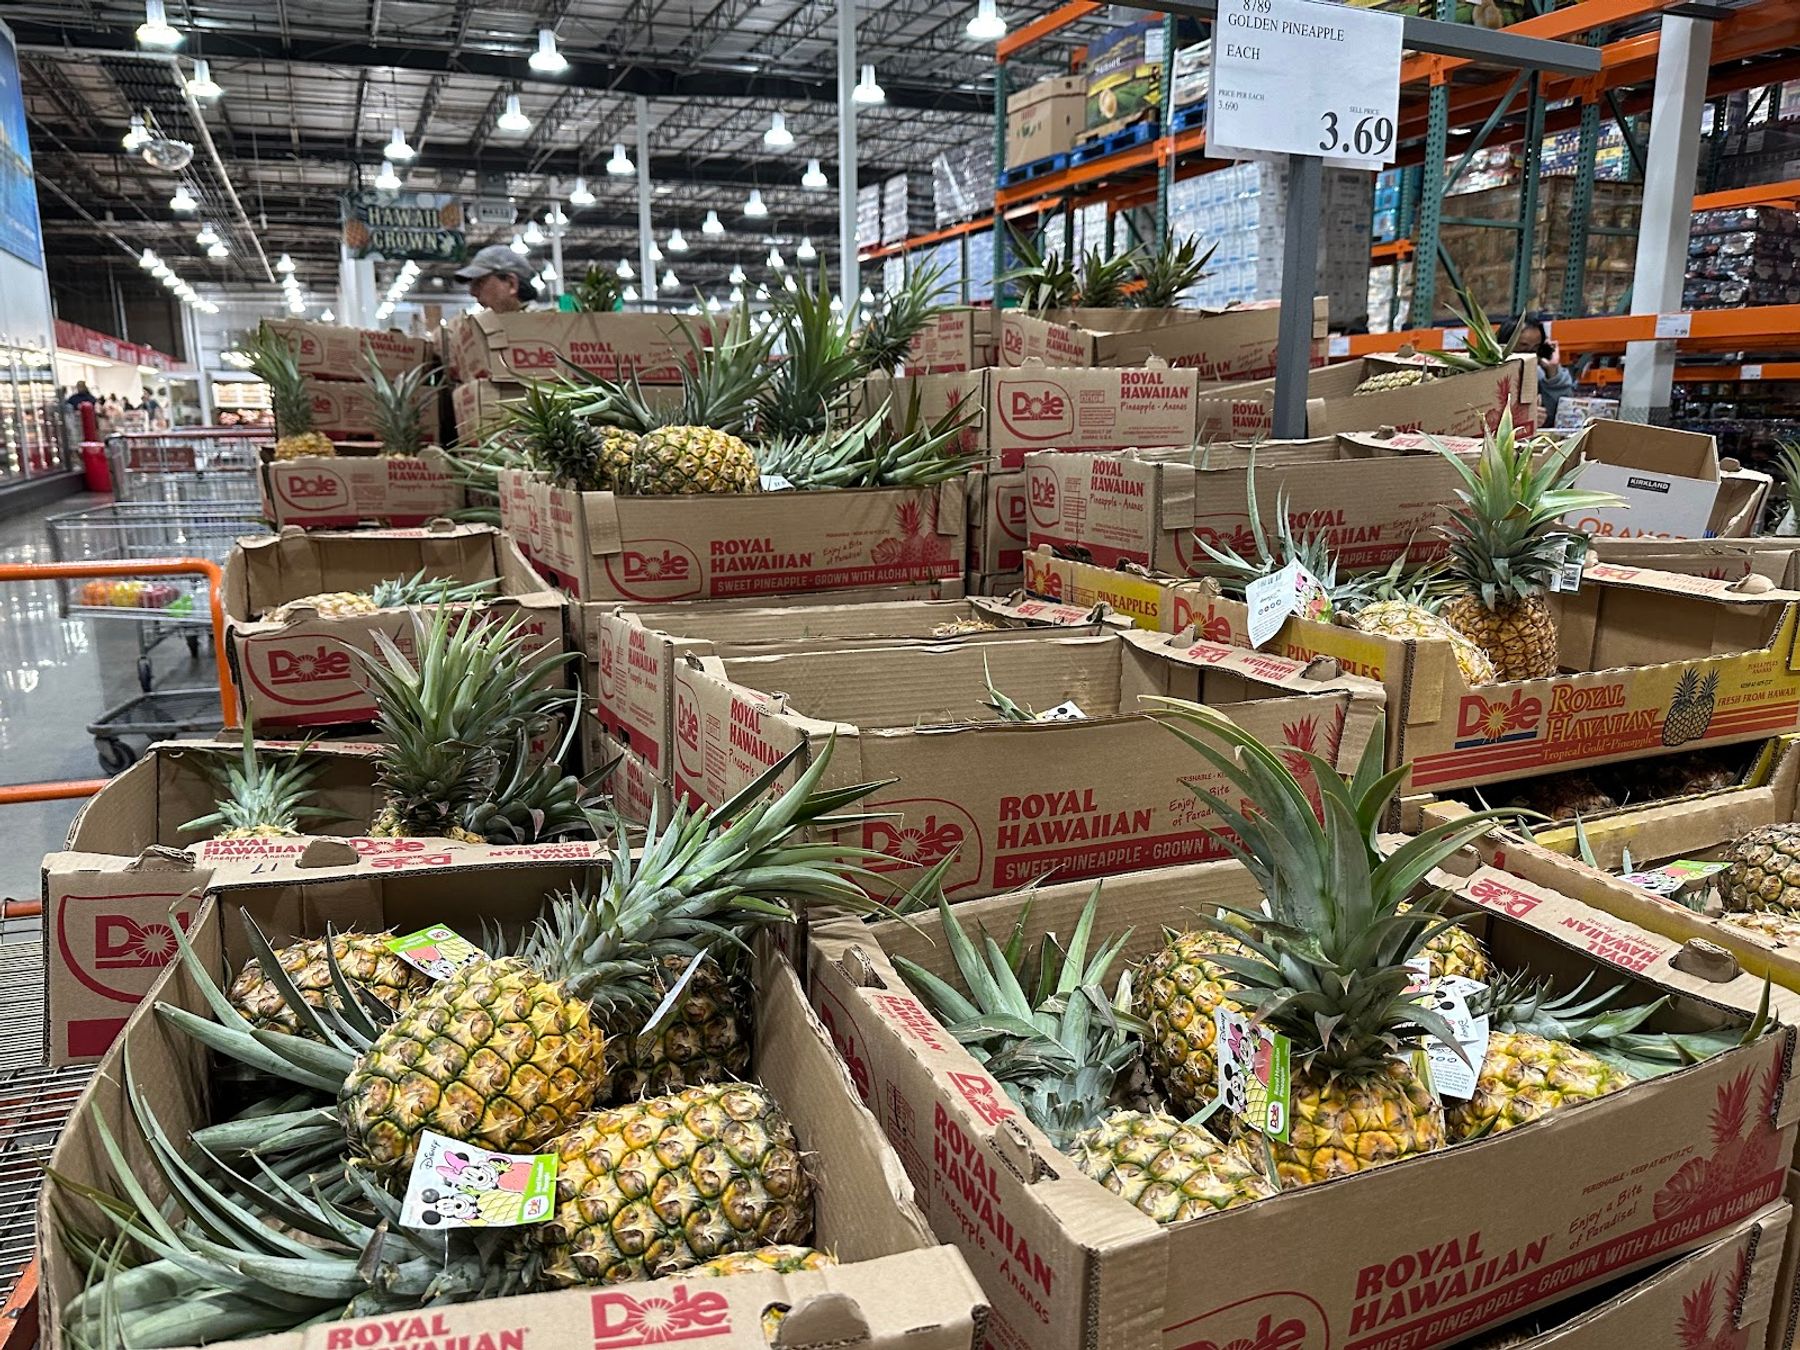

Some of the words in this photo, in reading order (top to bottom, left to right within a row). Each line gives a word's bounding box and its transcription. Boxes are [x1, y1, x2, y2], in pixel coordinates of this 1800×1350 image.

[1243, 0, 1272, 14] 8789
[1228, 13, 1279, 32] GOLDEN
[1282, 21, 1345, 42] PINEAPPLE
[1226, 44, 1260, 60] EACH
[1218, 100, 1239, 111] 3.690
[1349, 106, 1362, 114] SELL
[1319, 112, 1393, 155] 3.69
[368, 206, 438, 227] HAWAII
[372, 231, 438, 250] GROWN
[1005, 329, 1022, 350] Dole
[1048, 328, 1069, 340] ROYAL
[512, 348, 556, 364] Dole
[570, 341, 613, 352] ROYAL
[570, 353, 642, 365] HAWAIIAN
[1200, 361, 1231, 376] AIIAN
[1121, 373, 1164, 384] ROYAL
[1121, 387, 1189, 399] HAWAIIAN
[1012, 392, 1064, 417] Dole
[1121, 402, 1155, 414] Pineapple
[1163, 402, 1188, 411] Ananas
[1232, 404, 1265, 415] ROYAL
[1232, 417, 1271, 428] HAWAII
[388, 461, 428, 471] ROYAL
[1093, 460, 1123, 477] ROYAL
[289, 475, 336, 494] Dole
[1032, 477, 1056, 504] Dole
[1091, 477, 1144, 497] HAWAIIAN
[1630, 478, 1669, 490] KIRKLAND
[1090, 494, 1117, 510] Pineapple
[1288, 510, 1346, 529] ROYAL
[1579, 517, 1689, 539] ORA
[1193, 525, 1257, 557] Dole
[1291, 526, 1381, 545] AIIAN
[710, 538, 775, 556] ROYAL
[624, 551, 689, 577] Dole
[710, 553, 812, 573] HAWAIIAN
[718, 579, 751, 591] SWEET
[753, 575, 807, 590] PINEAPPLE
[815, 573, 848, 585] GROWN
[851, 570, 875, 583] WITH
[878, 568, 908, 580] ALOHA
[910, 567, 920, 577] IN
[1026, 558, 1062, 599] Dole
[1097, 590, 1158, 617] PINEAPPLES
[1174, 596, 1231, 644] Dole
[629, 629, 645, 651] ROYAL
[268, 646, 349, 678] Dole
[628, 648, 657, 676] HAWAIIAN
[1188, 645, 1233, 663] Dole
[1240, 656, 1296, 674] HAWAIIAN
[1251, 667, 1288, 681] ROYAL
[1550, 683, 1625, 714] ROYAL
[1717, 696, 1741, 707] FRESH
[1743, 692, 1766, 703] FROM
[1767, 687, 1797, 699] HAWAII
[679, 694, 699, 746] Dole
[731, 697, 761, 735] ROYAL
[1457, 689, 1543, 741] Dole
[1546, 708, 1661, 744] HAWAIIAN
[1543, 743, 1581, 760] Tropical
[1000, 789, 1097, 821] ROYAL
[1169, 796, 1197, 811] Enjoy
[1209, 786, 1230, 796] Bite
[997, 809, 1152, 850] HAWAIIAN
[1172, 814, 1183, 826] of
[206, 839, 272, 848] ROYAL
[350, 839, 426, 855] Dole
[863, 816, 964, 858] Dole
[203, 854, 255, 863] Pineapple
[370, 853, 452, 868] Dole
[490, 847, 590, 857] HAWAIIAN
[532, 852, 591, 860] ROYAL
[1005, 859, 1059, 880] SWEET
[1063, 848, 1141, 875] PINEAPPLE
[1153, 839, 1204, 860] GROWN
[1470, 878, 1543, 918] Dole
[96, 912, 188, 968] Dol
[1559, 916, 1660, 964] HAWAIIAN
[1586, 940, 1649, 972] ROYAL
[884, 995, 946, 1052] HAWAIIAN
[900, 998, 939, 1033] ROYAL
[947, 1071, 1017, 1126] Dole
[420, 1139, 441, 1169] Disney
[934, 1101, 1001, 1204] ROYAL
[933, 1134, 1052, 1296] HAWAIIAN
[1569, 1211, 1601, 1235] Enjoy
[1606, 1204, 1613, 1214] a
[1618, 1183, 1643, 1204] Bite
[1569, 1236, 1581, 1251] of
[1586, 1200, 1637, 1242] Paradise!
[933, 1168, 986, 1250] Pineapple
[1000, 1262, 1050, 1325] Ananas
[1355, 1231, 1485, 1300] ROYAL
[1361, 1326, 1424, 1350] WEET
[1428, 1283, 1527, 1341] PINEAPPLE
[1539, 1253, 1601, 1292] GROWN
[1605, 1233, 1649, 1265] WITH
[1648, 1214, 1702, 1250] ALOHA
[1703, 1207, 1723, 1227] IN
[1724, 1180, 1774, 1220] HAWAII
[1348, 1235, 1550, 1337] HAWAIIAN
[591, 1285, 730, 1341] Dole
[327, 1313, 451, 1349] ROYAL
